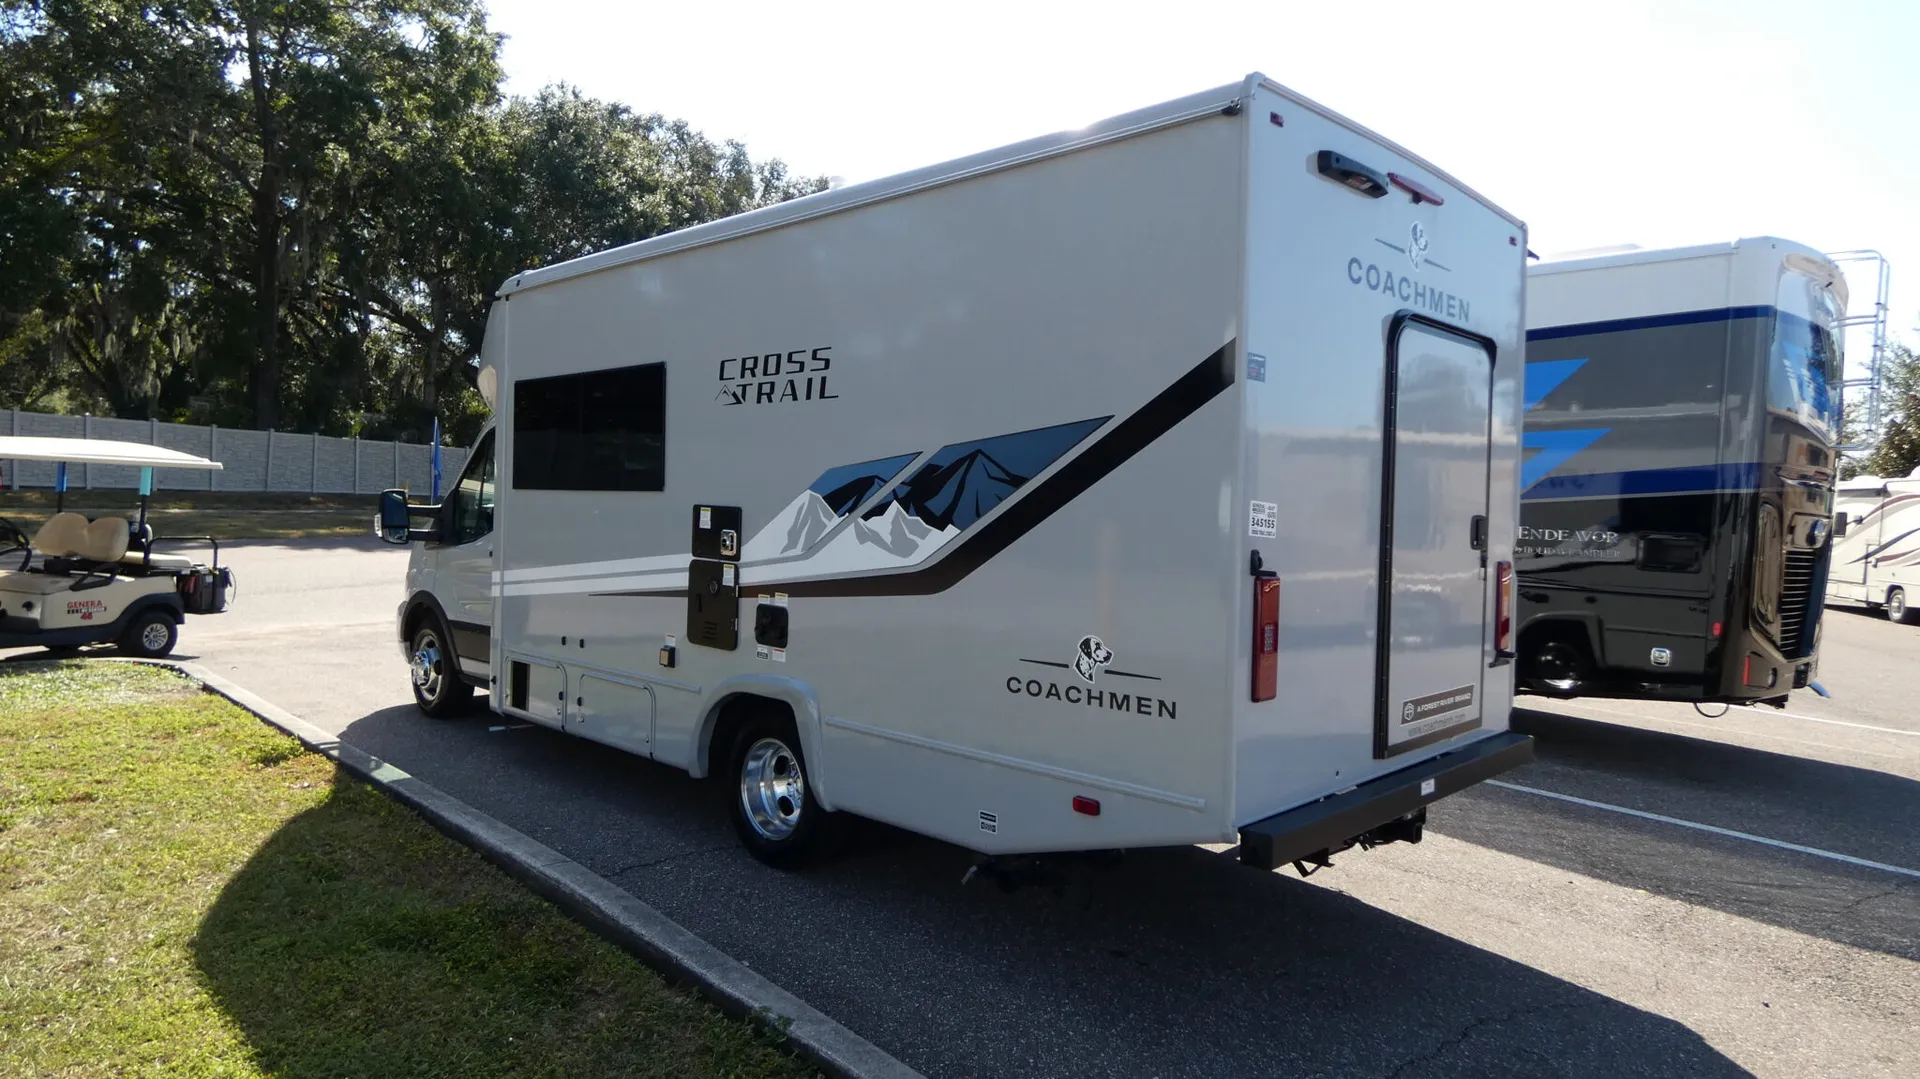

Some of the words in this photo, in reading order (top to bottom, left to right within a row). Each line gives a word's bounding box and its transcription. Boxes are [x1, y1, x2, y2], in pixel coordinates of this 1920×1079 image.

[1347, 257, 1471, 323] COACHMEN
[718, 346, 832, 381] CROSS
[736, 375, 839, 404] TRAIL
[1250, 516, 1276, 530] 345155
[1006, 676, 1177, 720] COACHMEN
[1423, 701, 1440, 711] FOREST
[1440, 697, 1455, 706] RIVER
[1455, 693, 1471, 702] BRAND
